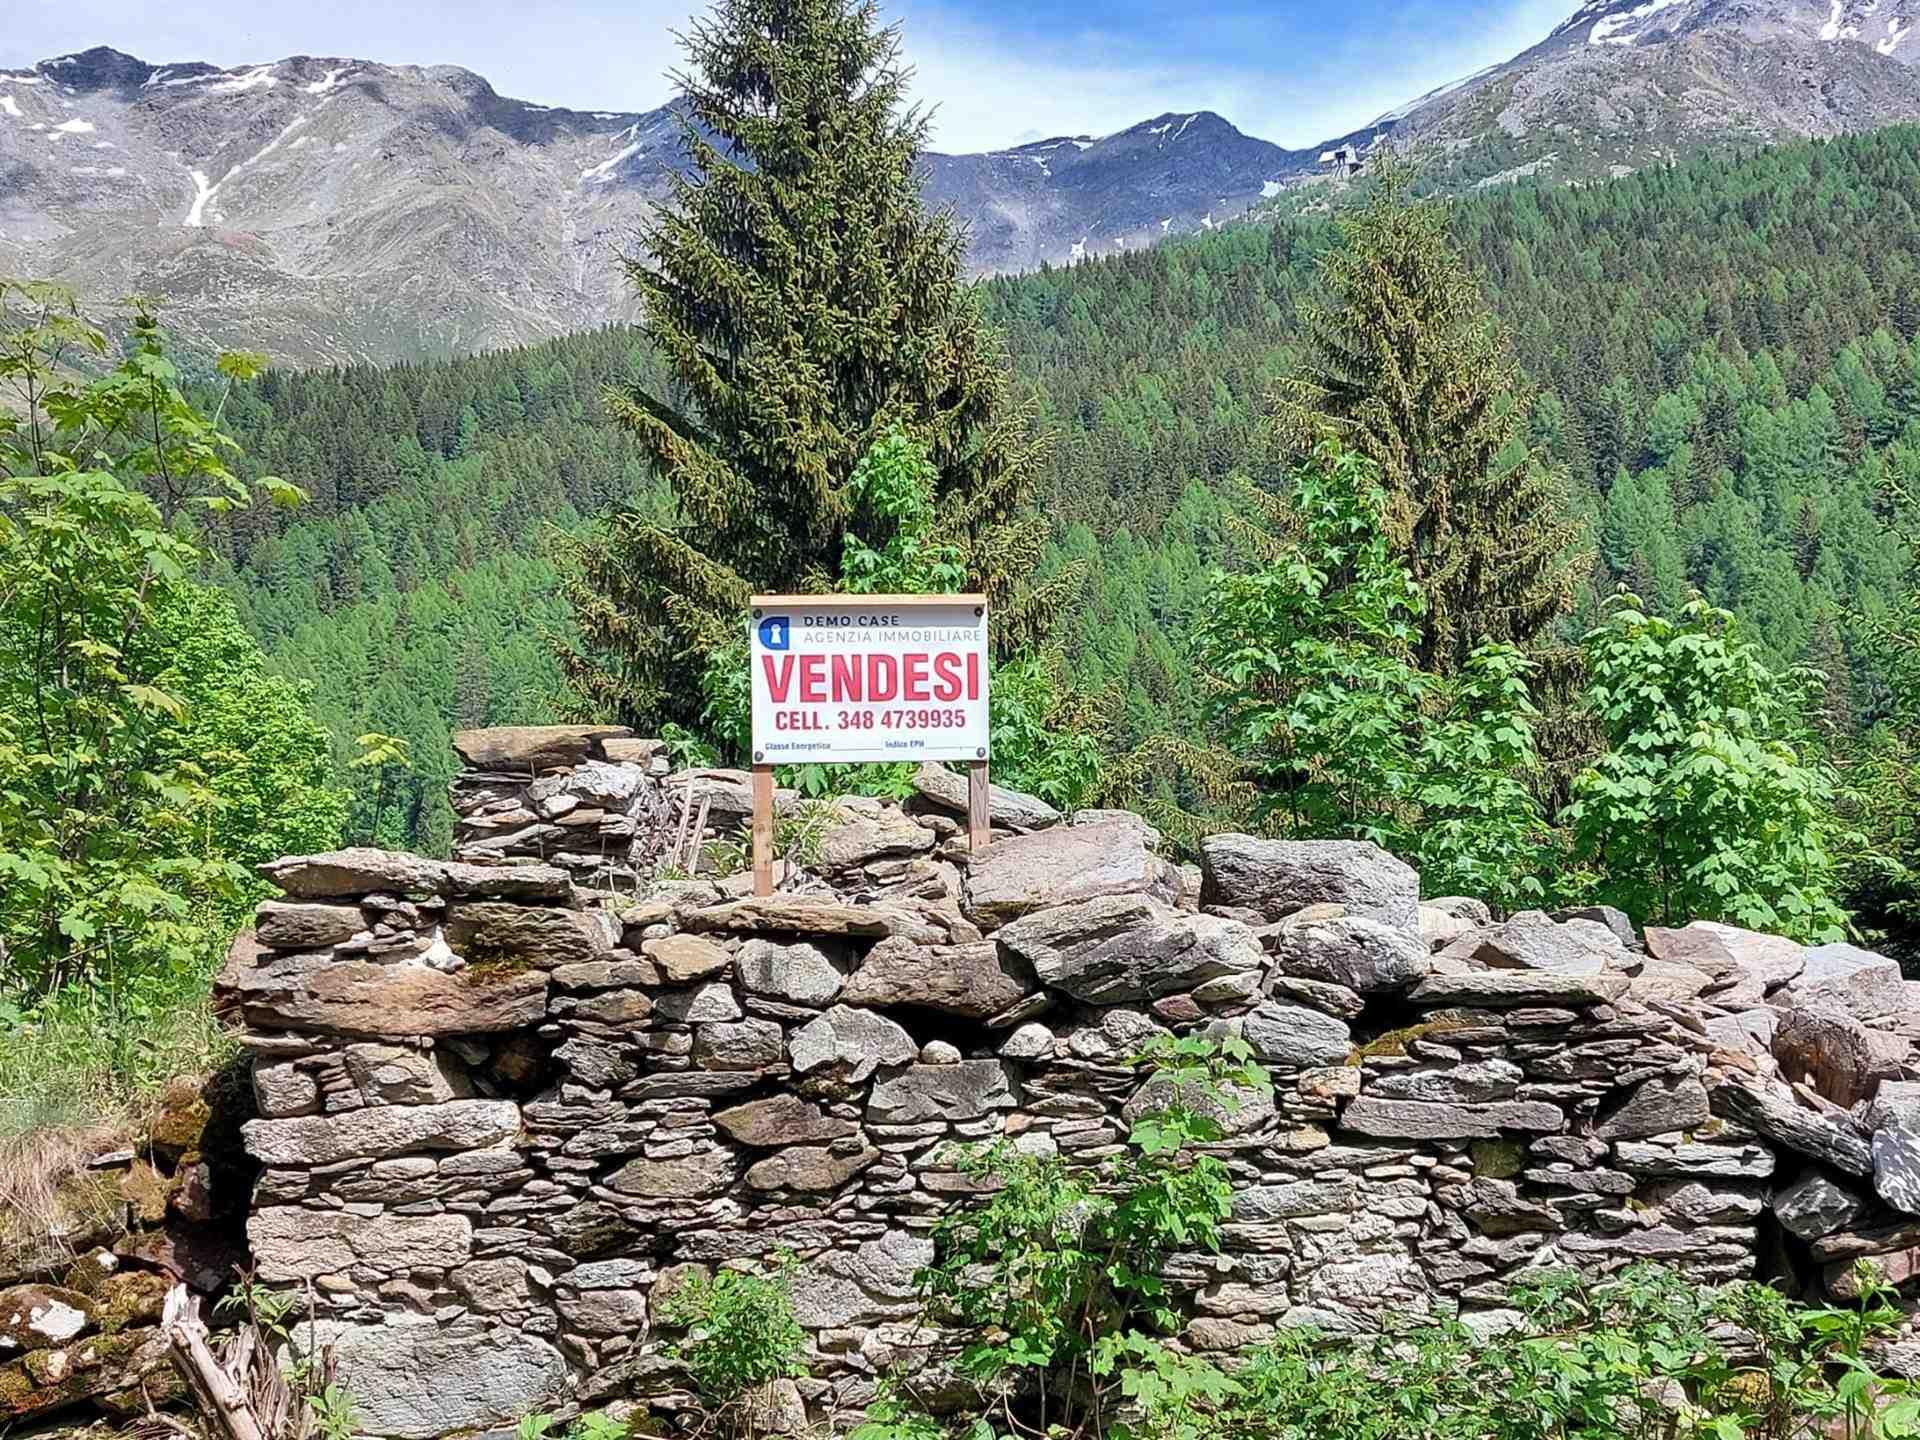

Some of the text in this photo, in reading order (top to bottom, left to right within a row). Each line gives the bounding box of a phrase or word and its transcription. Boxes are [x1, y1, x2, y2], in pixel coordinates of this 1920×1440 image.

[804, 615, 899, 627] DEMO CASE
[804, 630, 981, 643] AGENZIA IMMOBILIARE
[761, 652, 979, 703] VENDESI
[775, 708, 966, 730] CELL. 348 4739935
